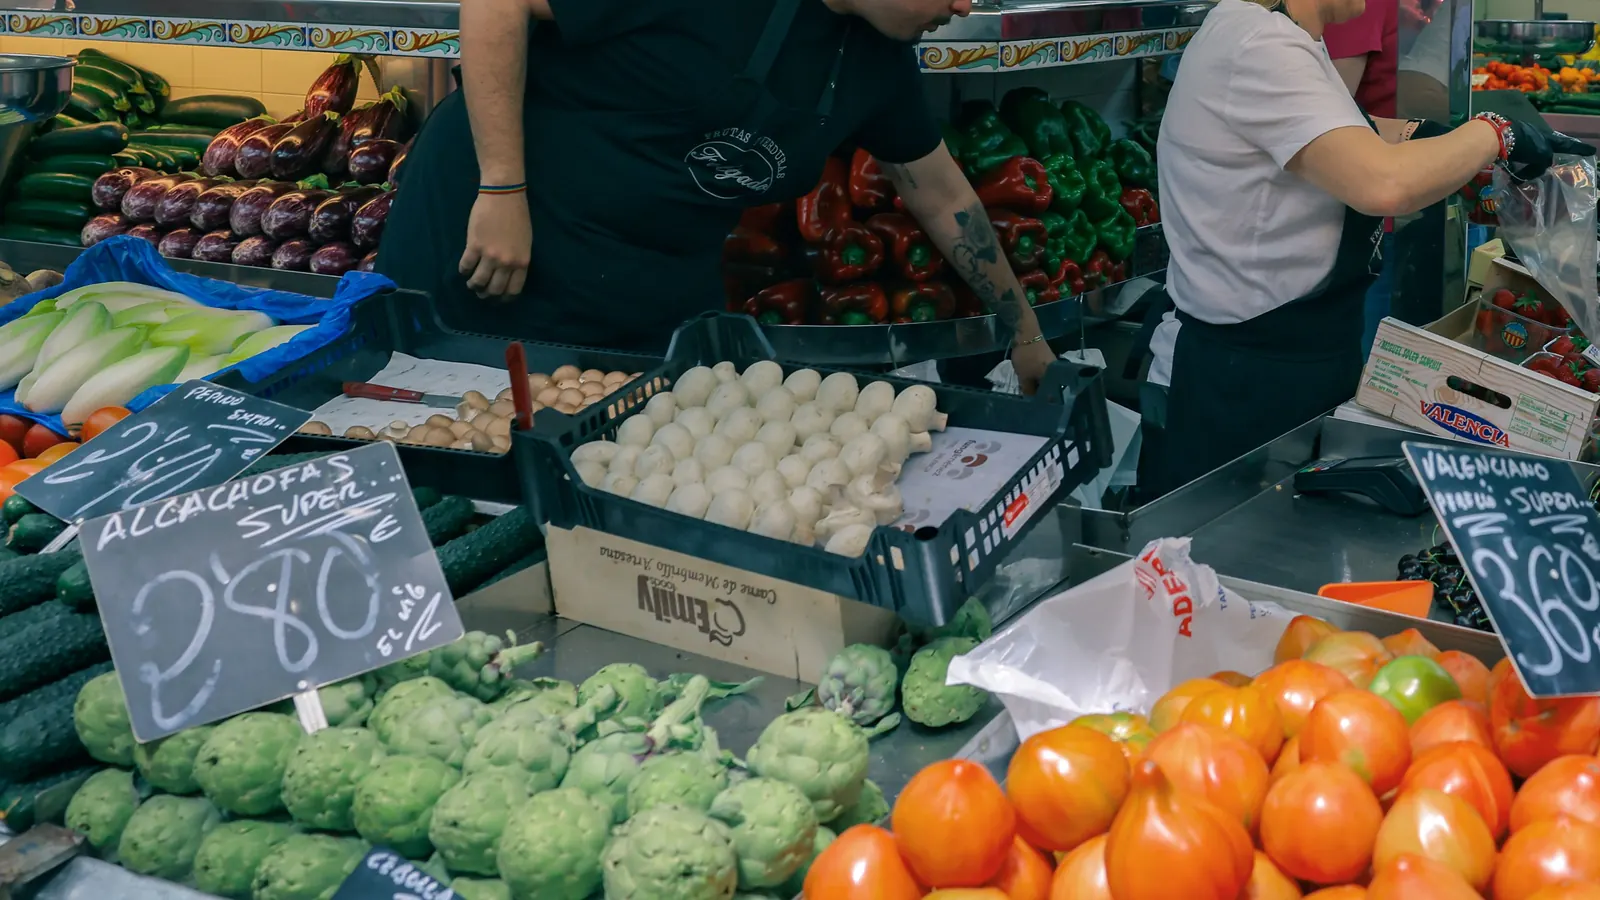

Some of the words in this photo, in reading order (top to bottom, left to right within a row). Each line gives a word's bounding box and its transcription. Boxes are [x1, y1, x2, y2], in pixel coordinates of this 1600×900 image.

[187, 386, 245, 407] PEPINO
[1419, 400, 1511, 448] VALENCIA
[1421, 449, 1550, 481] VALENCIANO
[96, 455, 356, 552] ALCACHOFAS
[599, 545, 655, 571] Artesana
[656, 561, 721, 589] Membrillo
[722, 578, 738, 595] de
[637, 573, 711, 634] Emily
[740, 583, 778, 605] Carne
